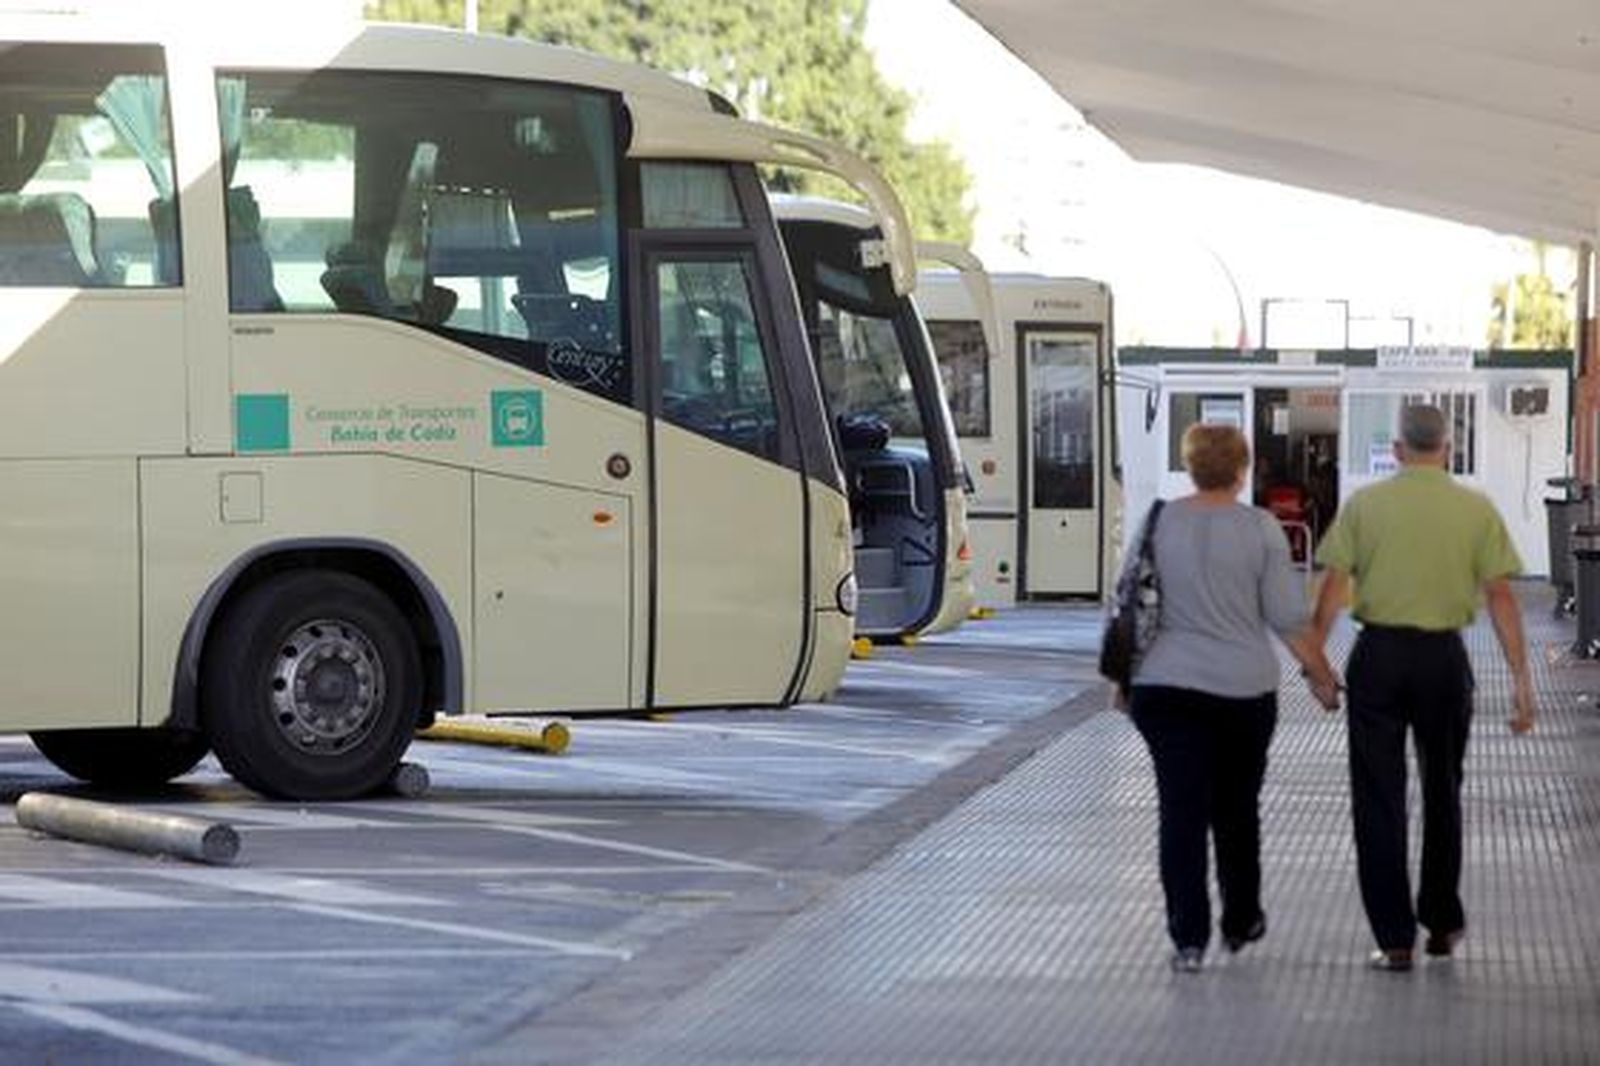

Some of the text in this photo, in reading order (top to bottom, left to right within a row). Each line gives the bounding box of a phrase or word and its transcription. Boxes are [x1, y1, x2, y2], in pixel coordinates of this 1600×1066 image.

[376, 406, 396, 420] de
[399, 404, 475, 422] Transportes
[385, 423, 405, 441] de
